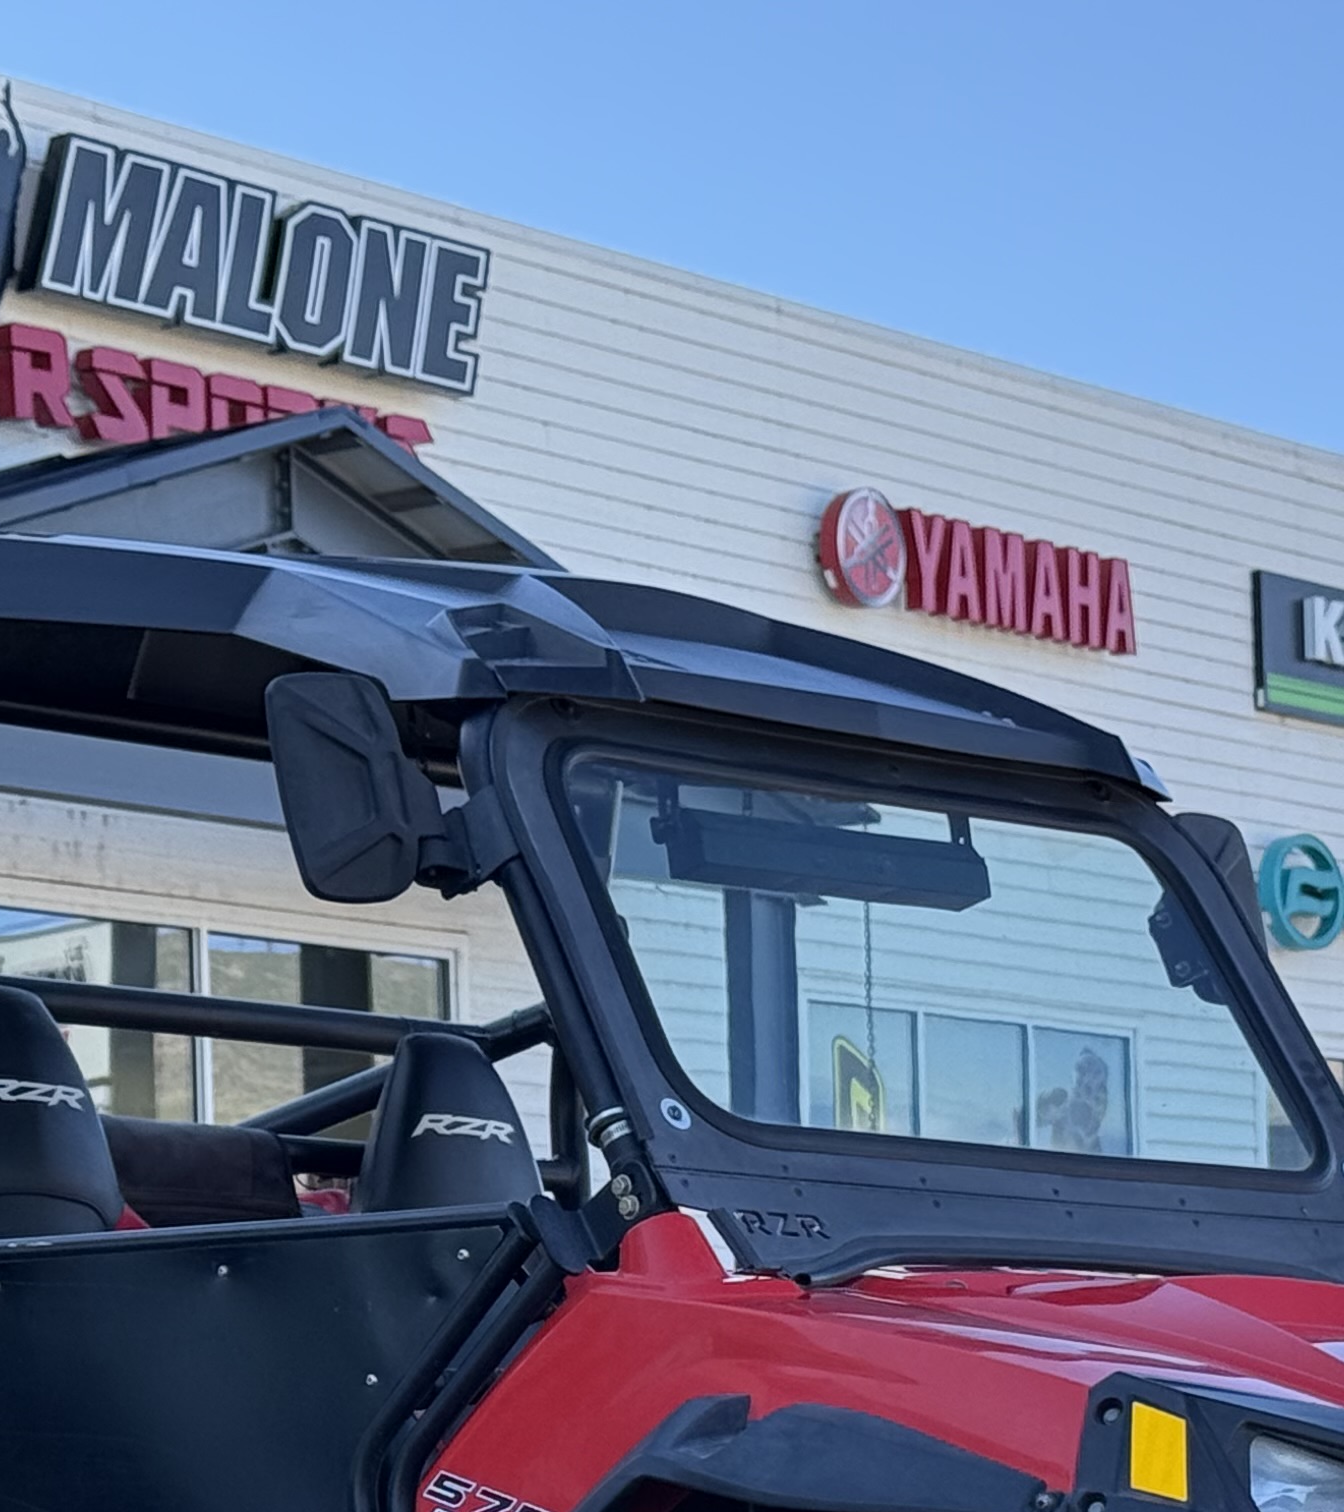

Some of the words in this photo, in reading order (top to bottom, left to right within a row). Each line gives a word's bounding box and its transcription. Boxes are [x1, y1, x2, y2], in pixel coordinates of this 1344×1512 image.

[28, 133, 490, 395] MALONE
[900, 508, 1136, 655] YAMAHA
[411, 1113, 516, 1145] RZR
[733, 1208, 831, 1240] RZR
